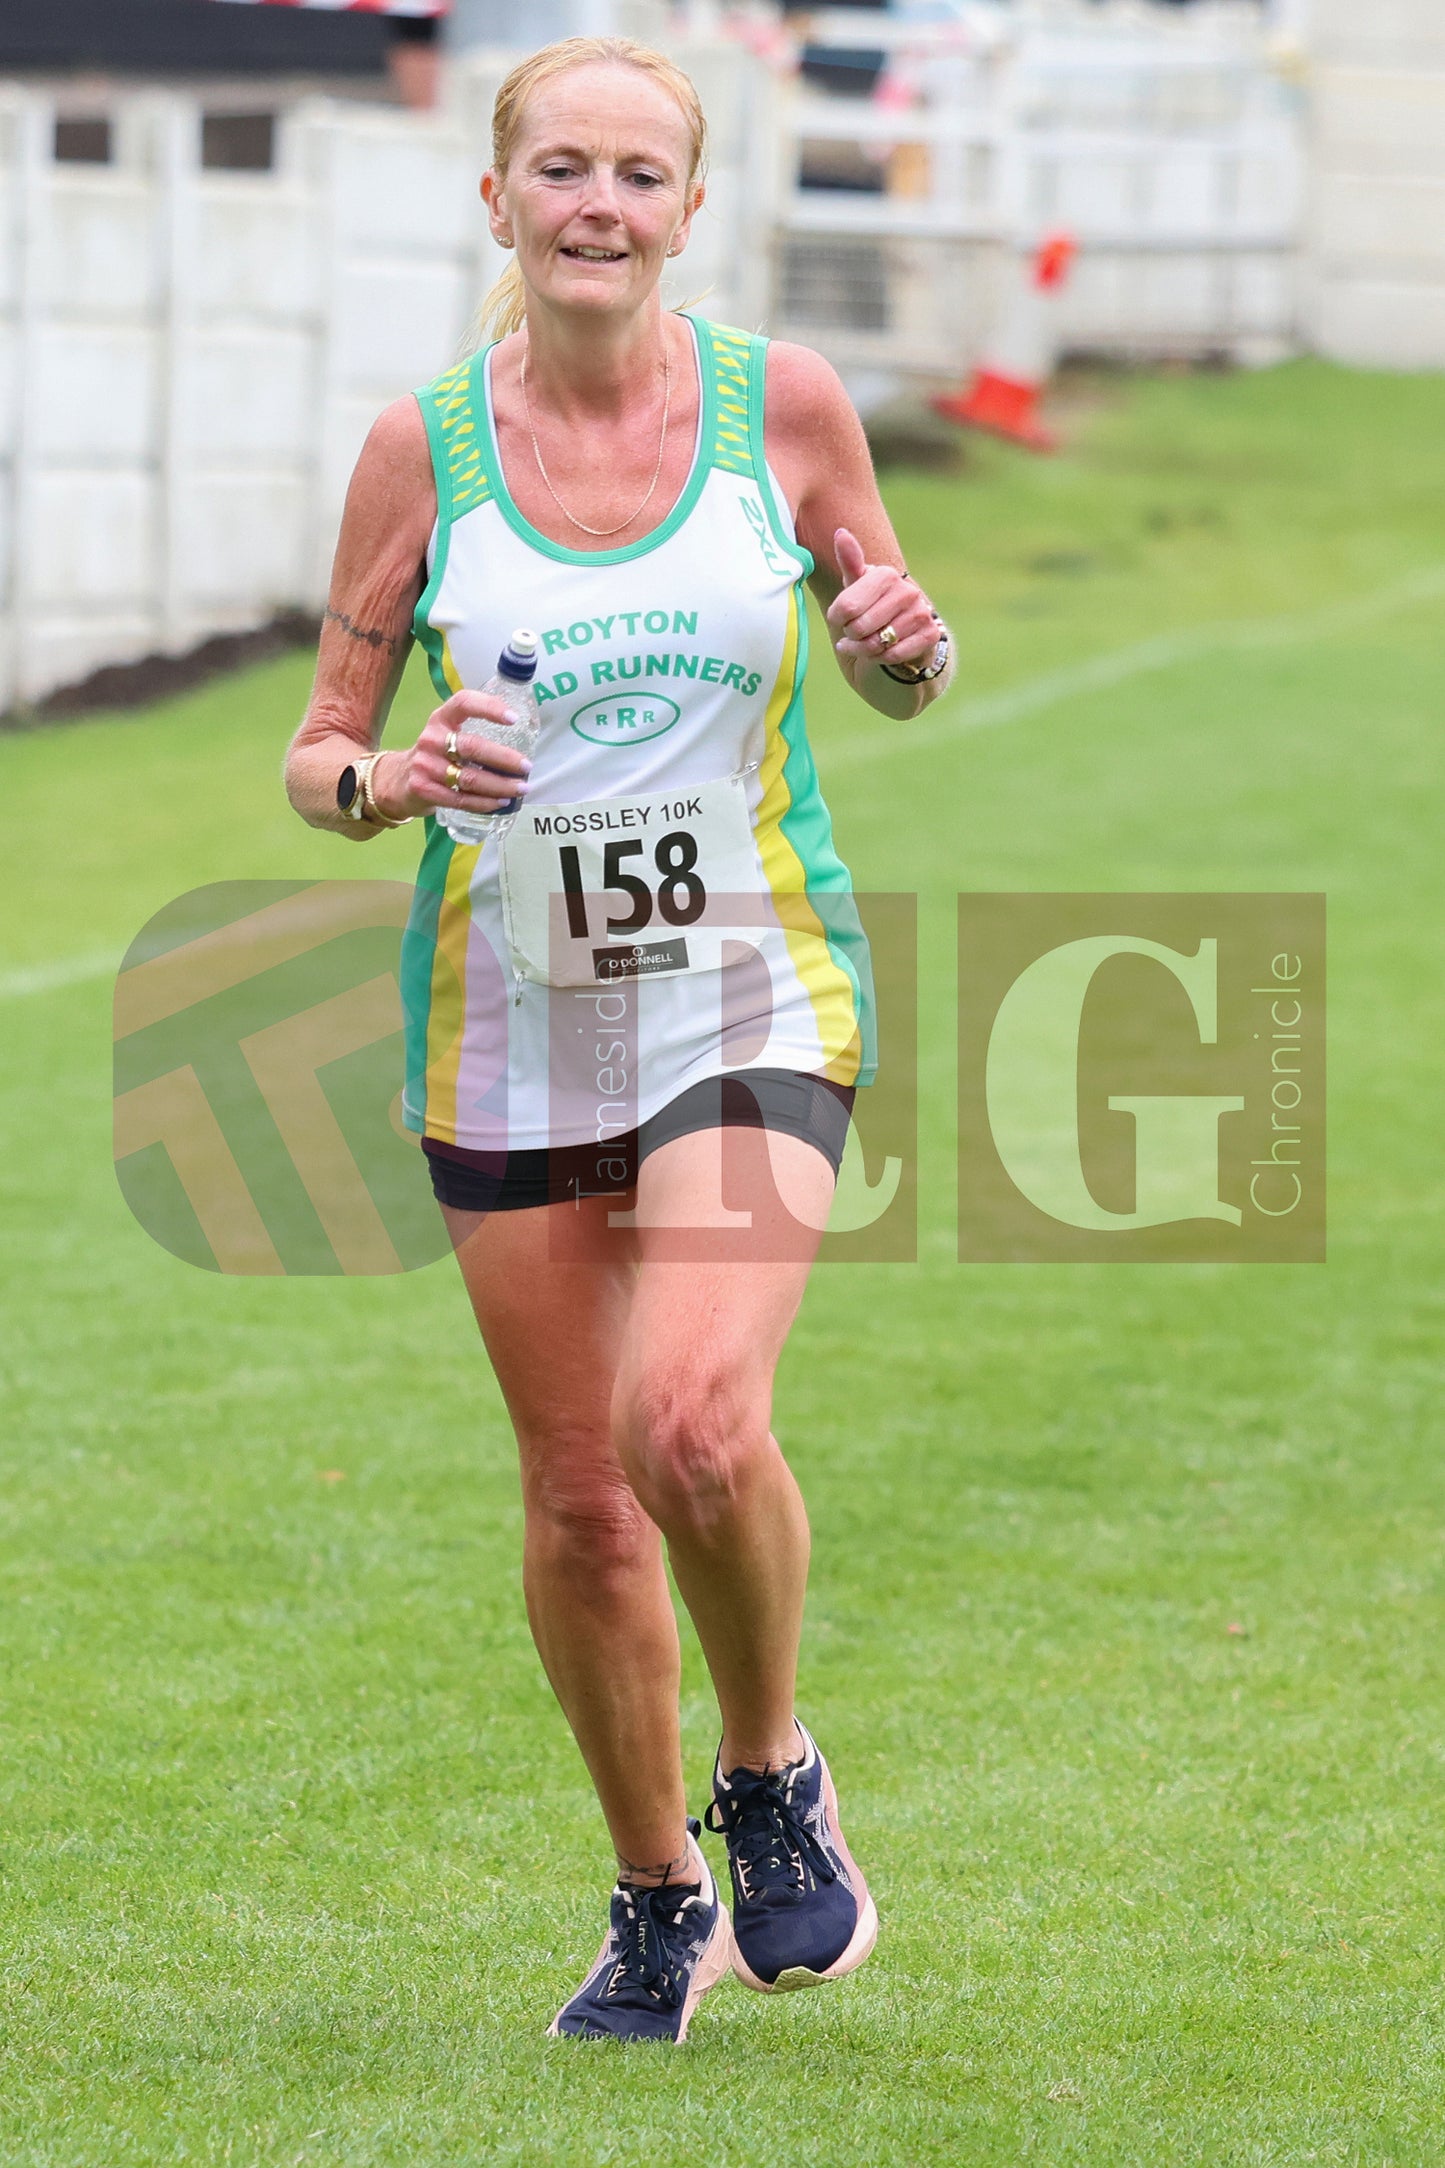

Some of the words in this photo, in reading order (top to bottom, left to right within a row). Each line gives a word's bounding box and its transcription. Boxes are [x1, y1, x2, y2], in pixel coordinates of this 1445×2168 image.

[738, 496, 792, 576] 2XU
[541, 609, 698, 656] ROYTON
[532, 671, 578, 706] AD
[590, 654, 762, 698] RUNNERS
[533, 806, 651, 836] MOSSLEY
[660, 796, 704, 823] 10K
[558, 831, 707, 939] 158
